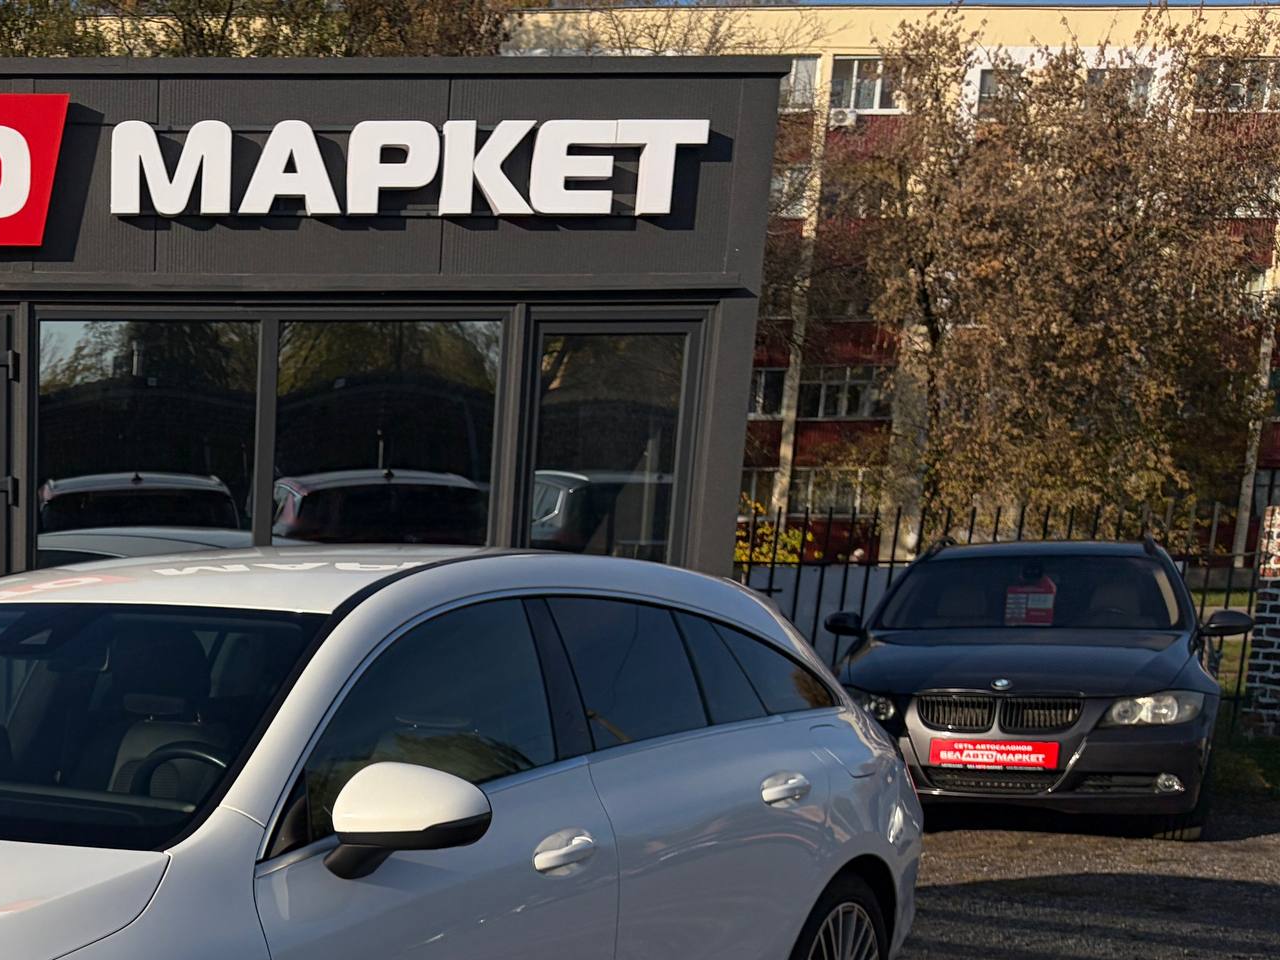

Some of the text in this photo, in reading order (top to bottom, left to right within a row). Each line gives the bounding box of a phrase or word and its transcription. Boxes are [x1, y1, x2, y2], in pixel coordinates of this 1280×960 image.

[110, 118, 711, 217] МАРКЕТ
[953, 742, 1033, 752] СЕТЬ АВТОСАЛОНОВ
